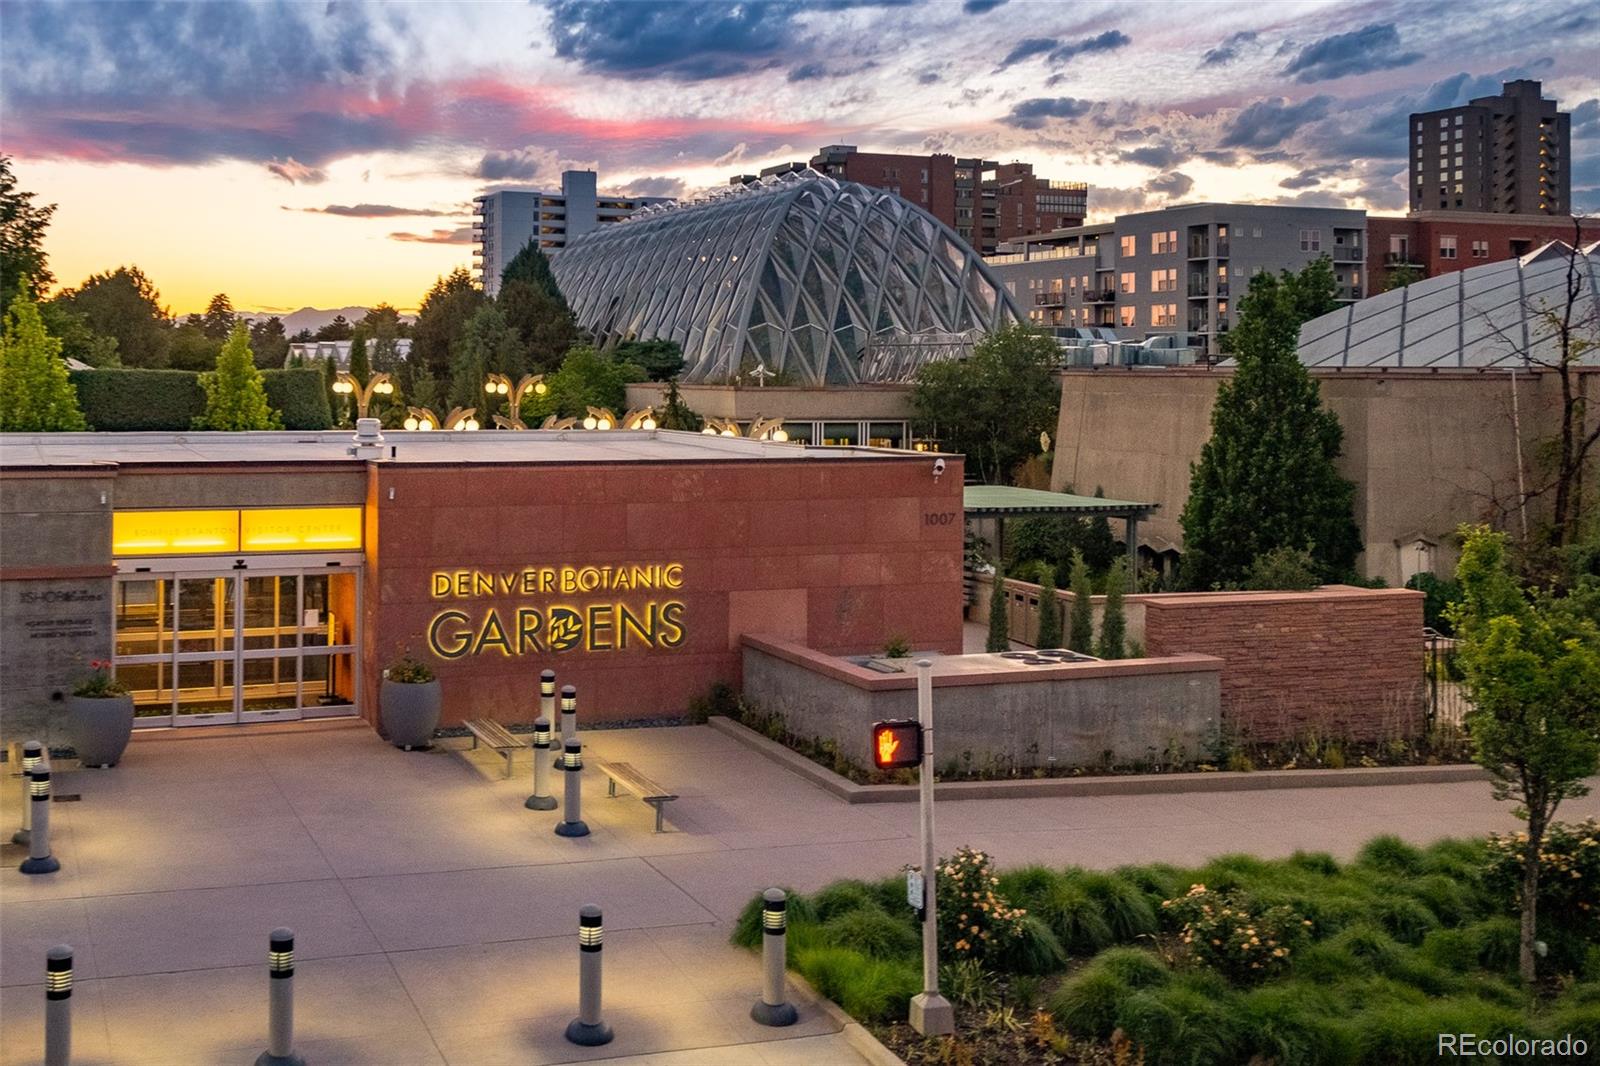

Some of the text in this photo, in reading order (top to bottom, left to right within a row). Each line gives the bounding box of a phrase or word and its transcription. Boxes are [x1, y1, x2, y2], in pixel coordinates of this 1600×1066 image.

[245, 524, 291, 535] VISITOR
[298, 523, 342, 534] CENTER
[924, 512, 956, 526] 1007
[433, 564, 685, 597] DENVER BOTANIC
[429, 600, 686, 660] GARDENS
